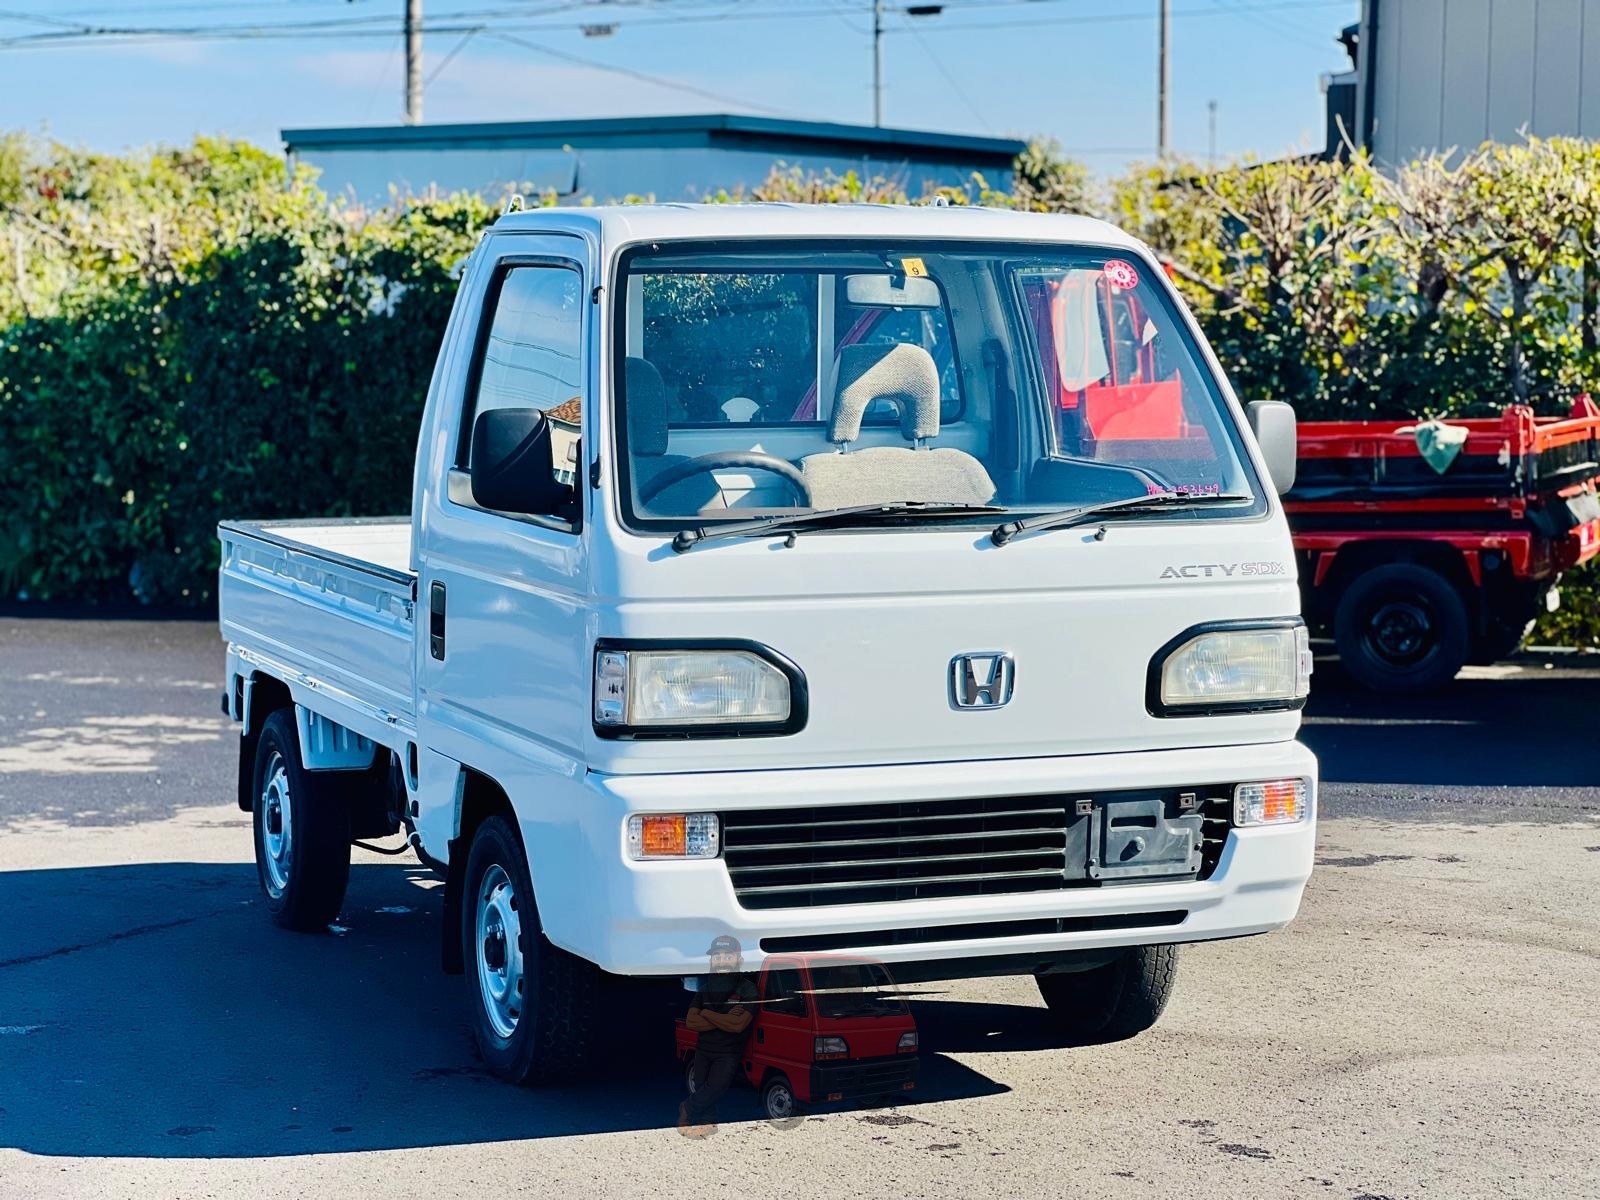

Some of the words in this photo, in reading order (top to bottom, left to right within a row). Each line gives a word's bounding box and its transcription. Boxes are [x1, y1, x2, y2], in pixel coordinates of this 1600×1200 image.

[911, 266, 920, 276] 9
[1159, 563, 1238, 579] ACTY
[1240, 561, 1285, 576] SDX
